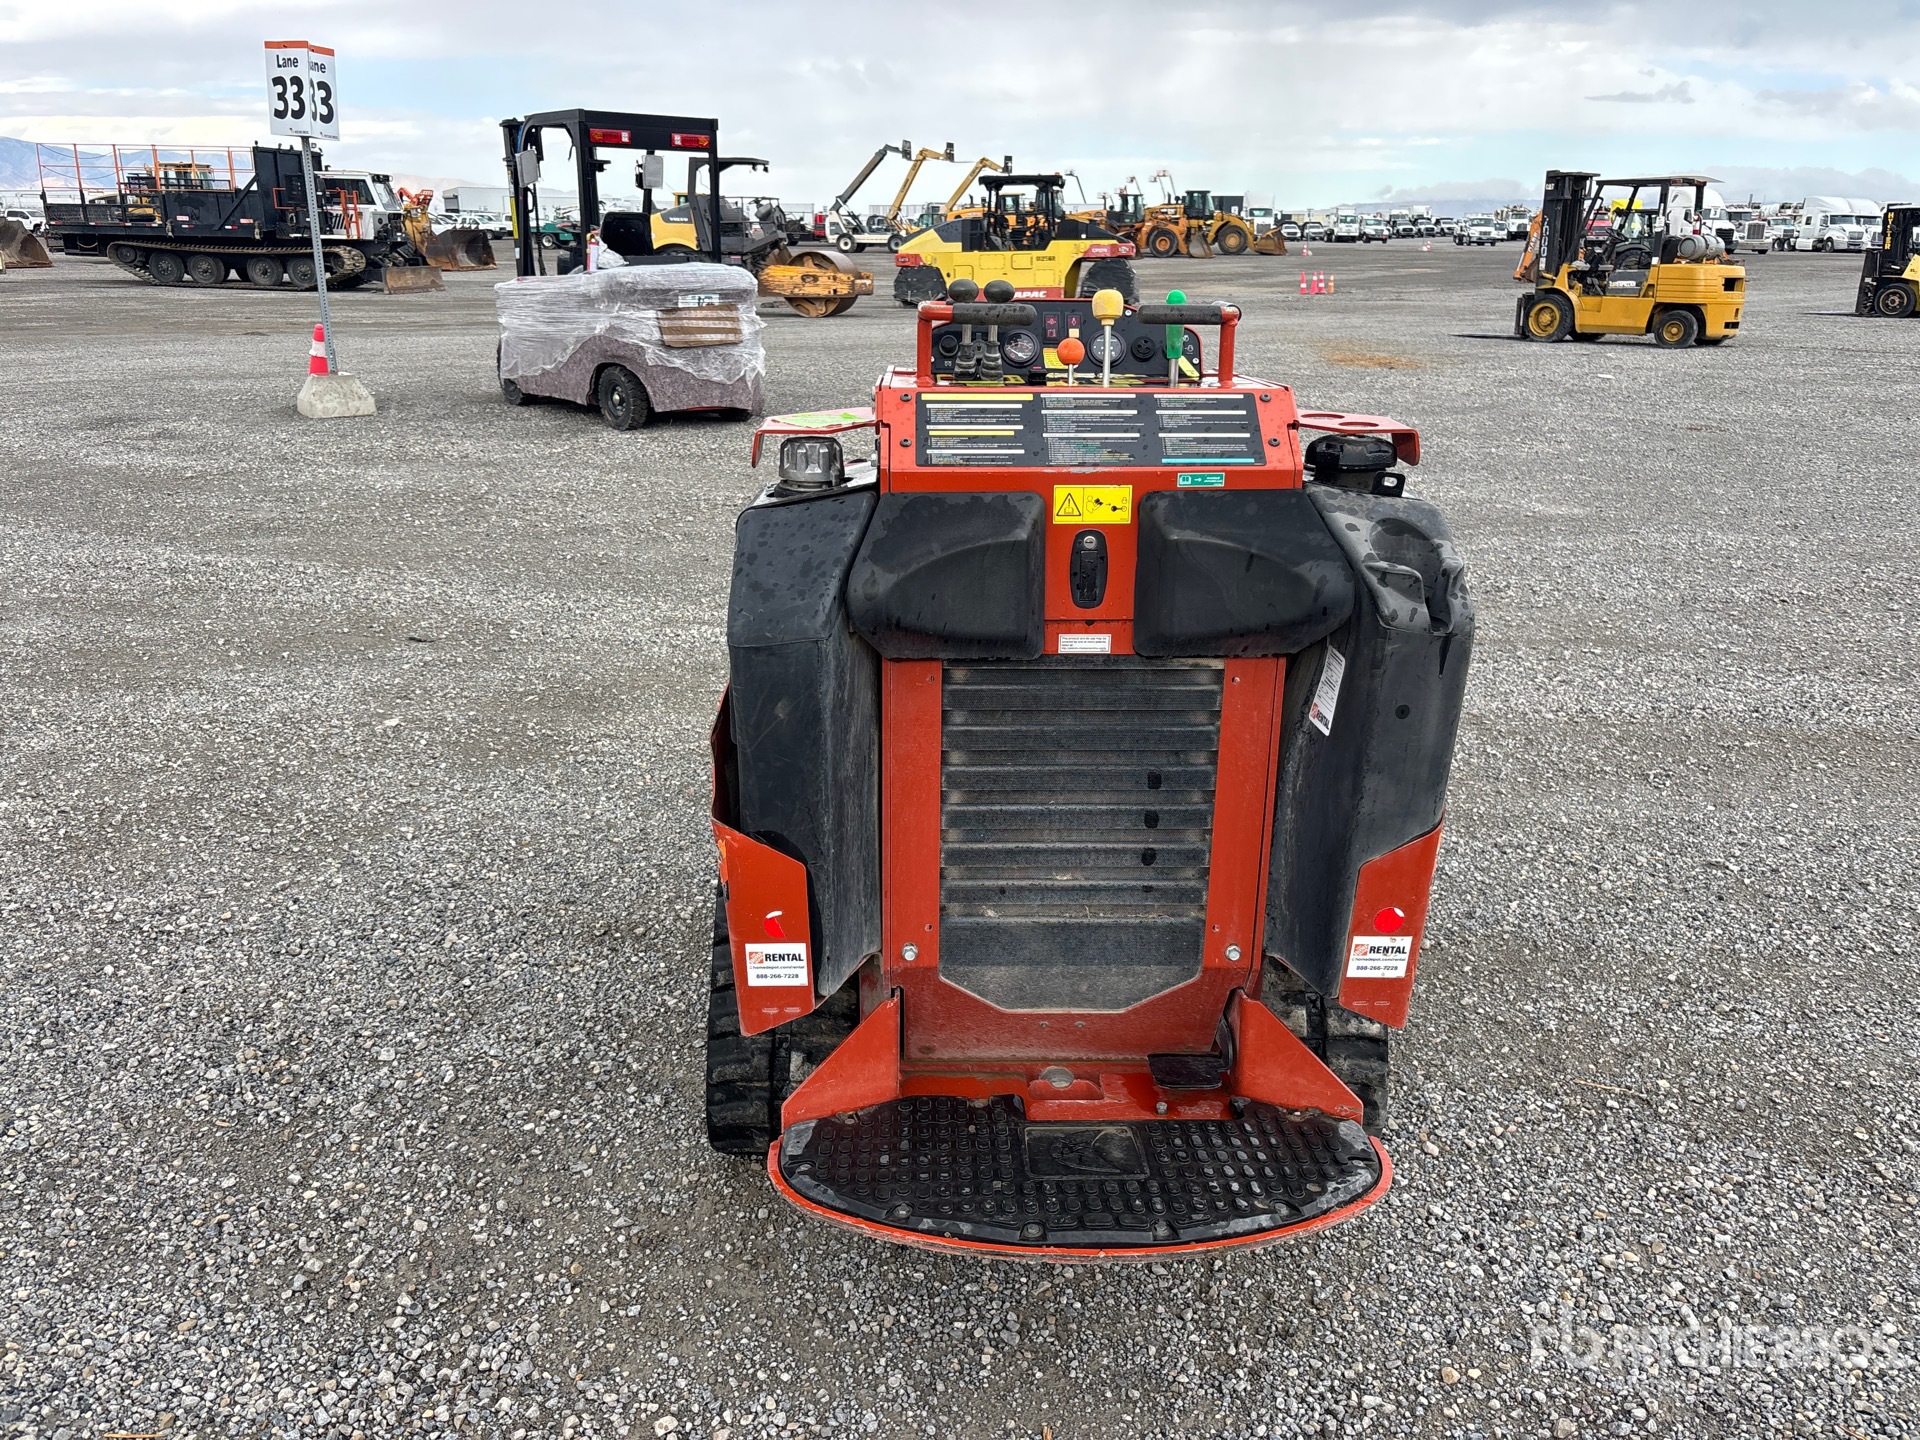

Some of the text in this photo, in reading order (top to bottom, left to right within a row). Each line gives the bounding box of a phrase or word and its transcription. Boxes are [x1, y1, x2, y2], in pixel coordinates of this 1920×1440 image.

[276, 54, 299, 69] Lane
[309, 60, 327, 74] ane
[271, 75, 306, 120] 33
[1884, 211, 1895, 250] HYSTER
[1014, 290, 1048, 299] APAC
[1369, 945, 1407, 954] RENTAL
[764, 953, 805, 962] RENTAL
